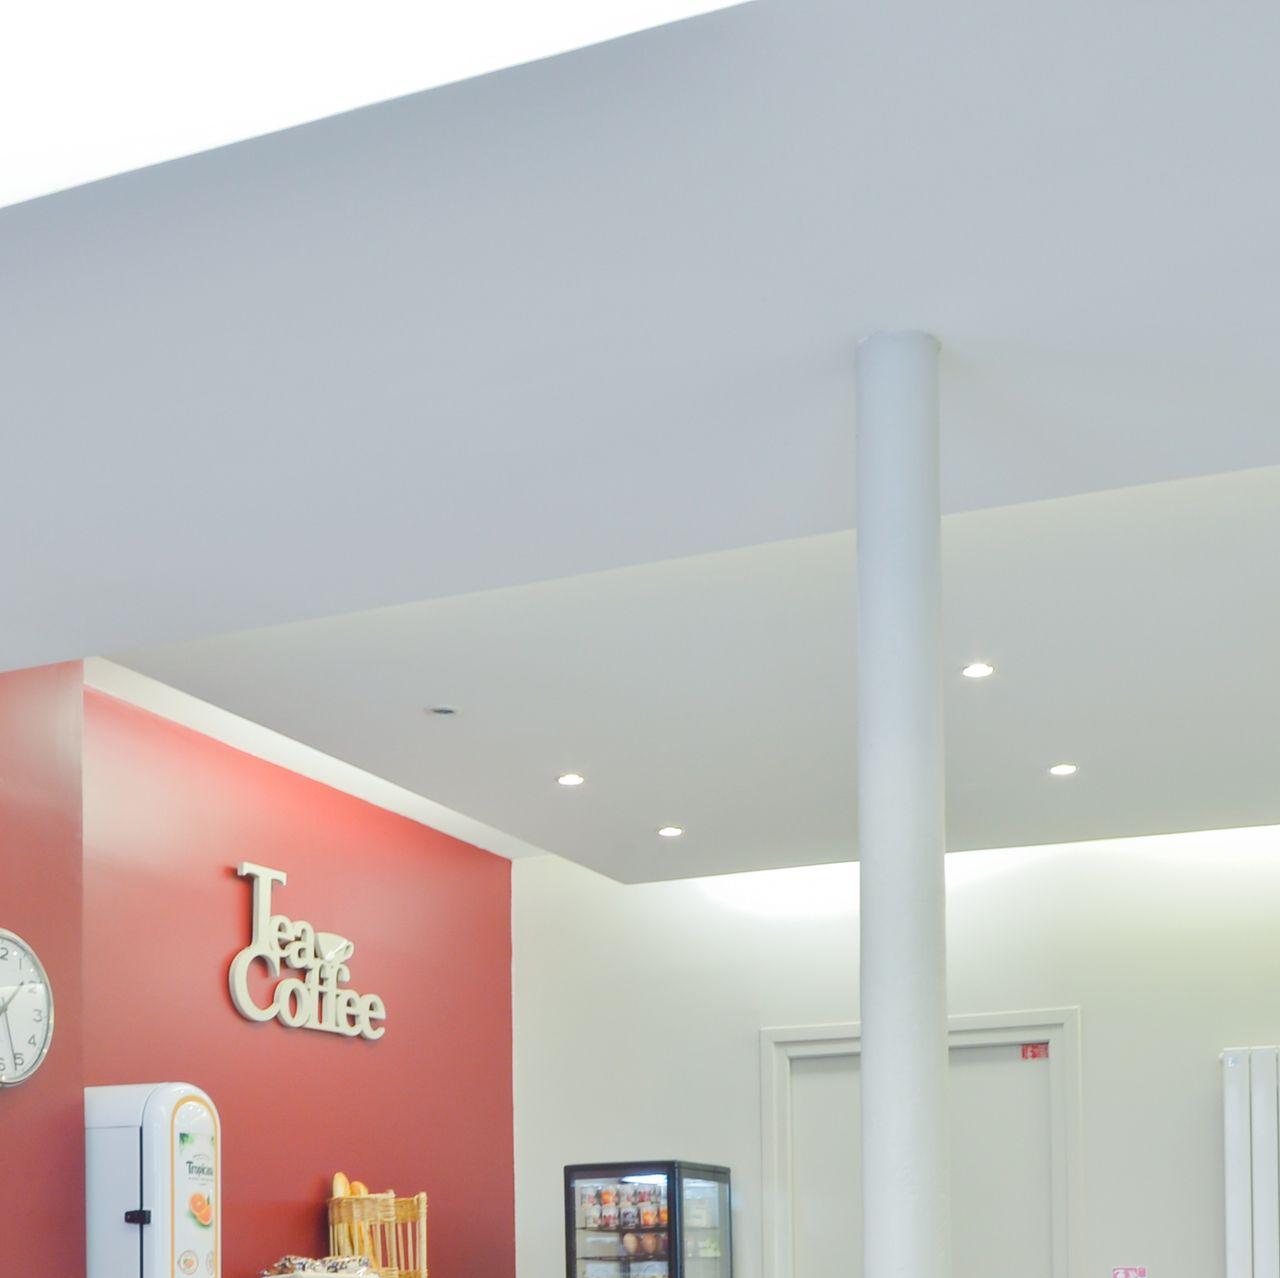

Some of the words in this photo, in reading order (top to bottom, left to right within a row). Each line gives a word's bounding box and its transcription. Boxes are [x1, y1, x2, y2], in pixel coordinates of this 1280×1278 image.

[237, 861, 316, 970] Tea
[33, 1008, 43, 1023] 3
[229, 944, 386, 1040] Coffee
[27, 1034, 37, 1047] 4
